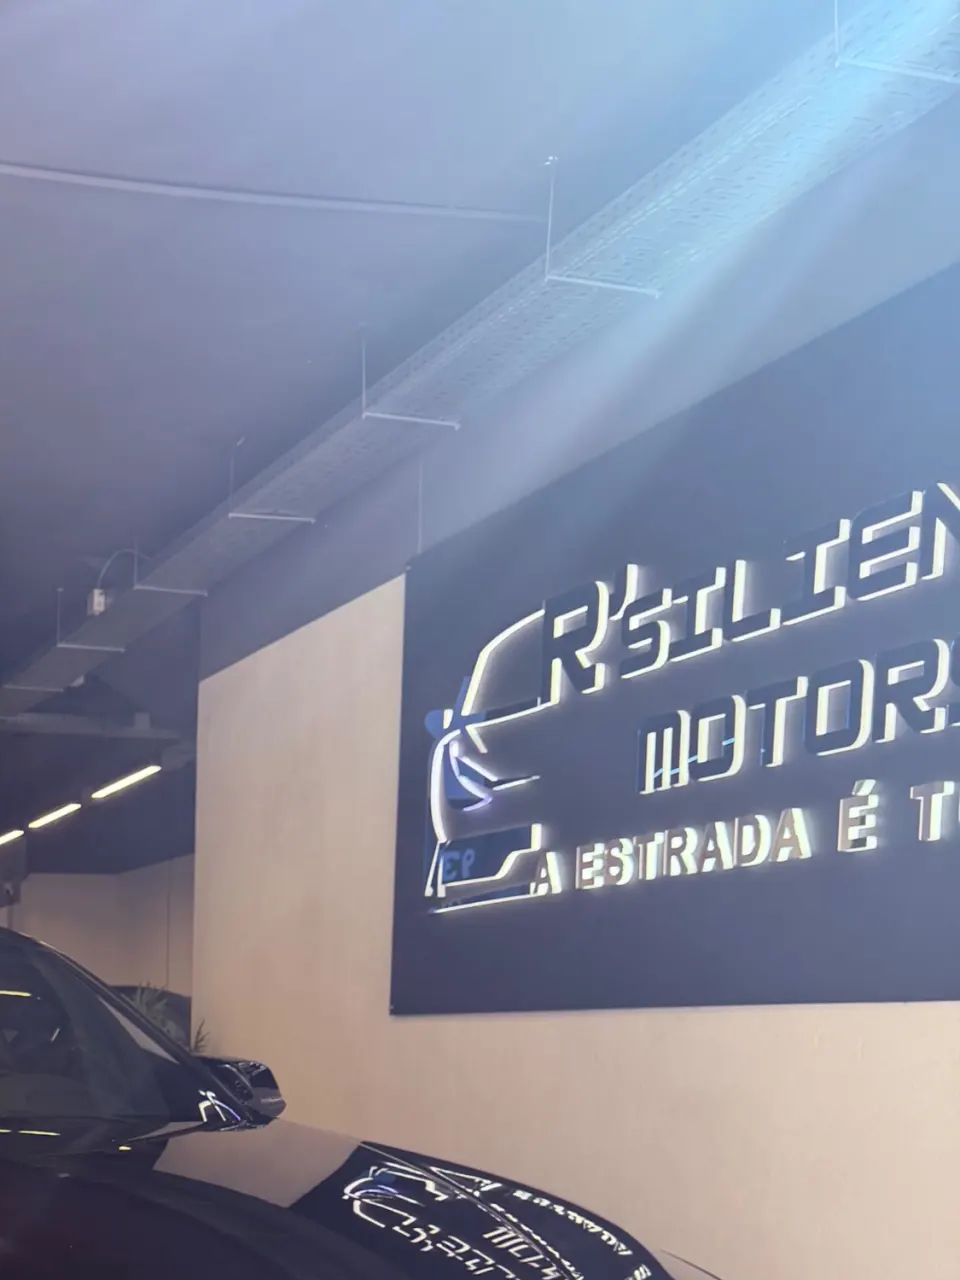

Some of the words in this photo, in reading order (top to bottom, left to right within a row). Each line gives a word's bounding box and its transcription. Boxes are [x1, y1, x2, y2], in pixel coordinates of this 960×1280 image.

[635, 634, 960, 796] MOTOR
[528, 850, 563, 896] A
[575, 808, 812, 890] ESTRADA
[838, 779, 879, 853] É
[910, 780, 960, 842] T
